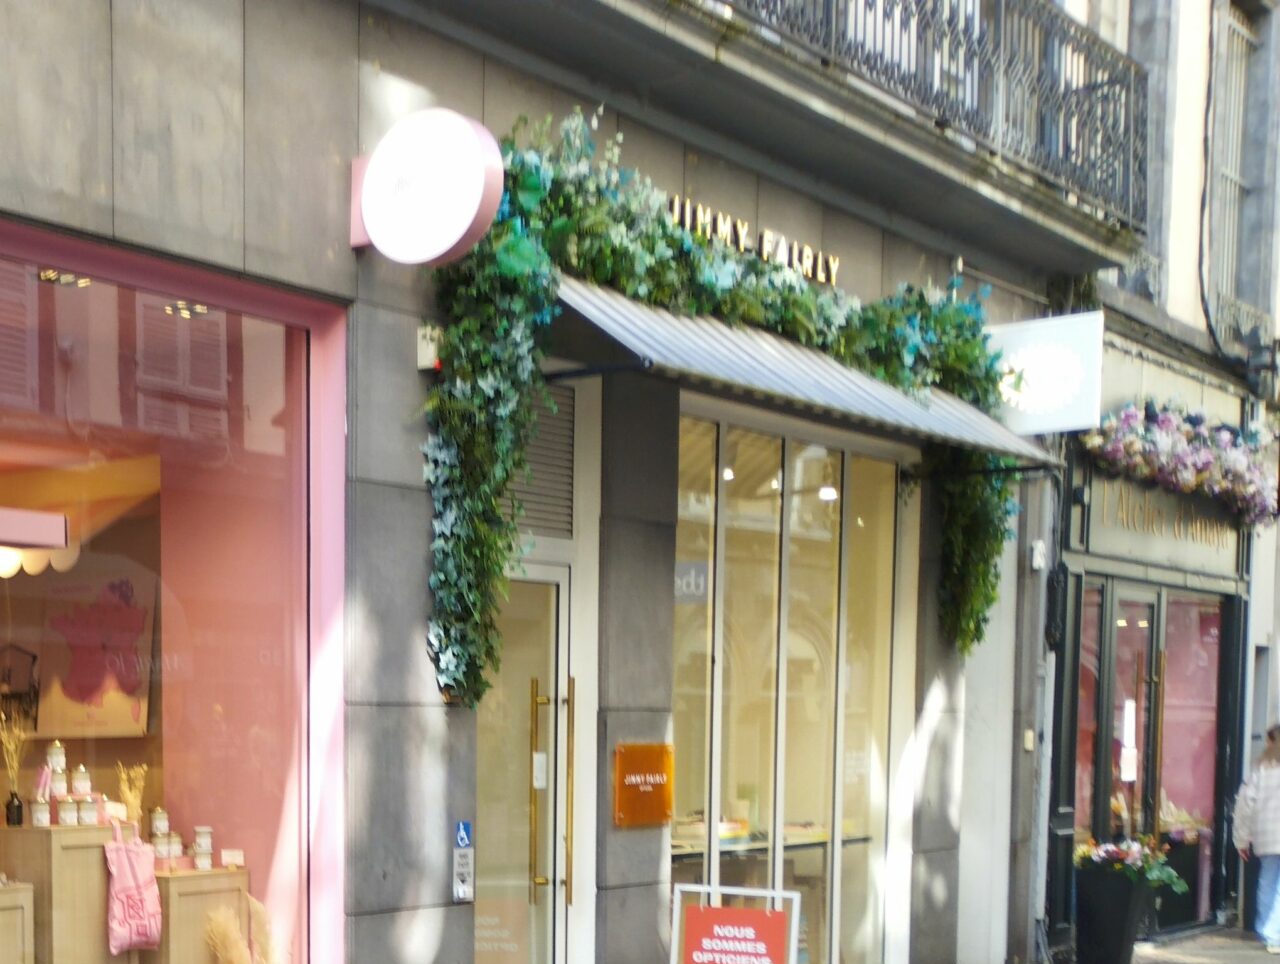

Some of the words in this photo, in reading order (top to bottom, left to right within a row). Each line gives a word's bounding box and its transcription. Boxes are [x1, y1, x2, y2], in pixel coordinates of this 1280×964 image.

[672, 194, 749, 252] JIMMY
[762, 228, 840, 287] FAIRLY
[713, 924, 756, 940] NOUS
[701, 937, 767, 955] SOMMES
